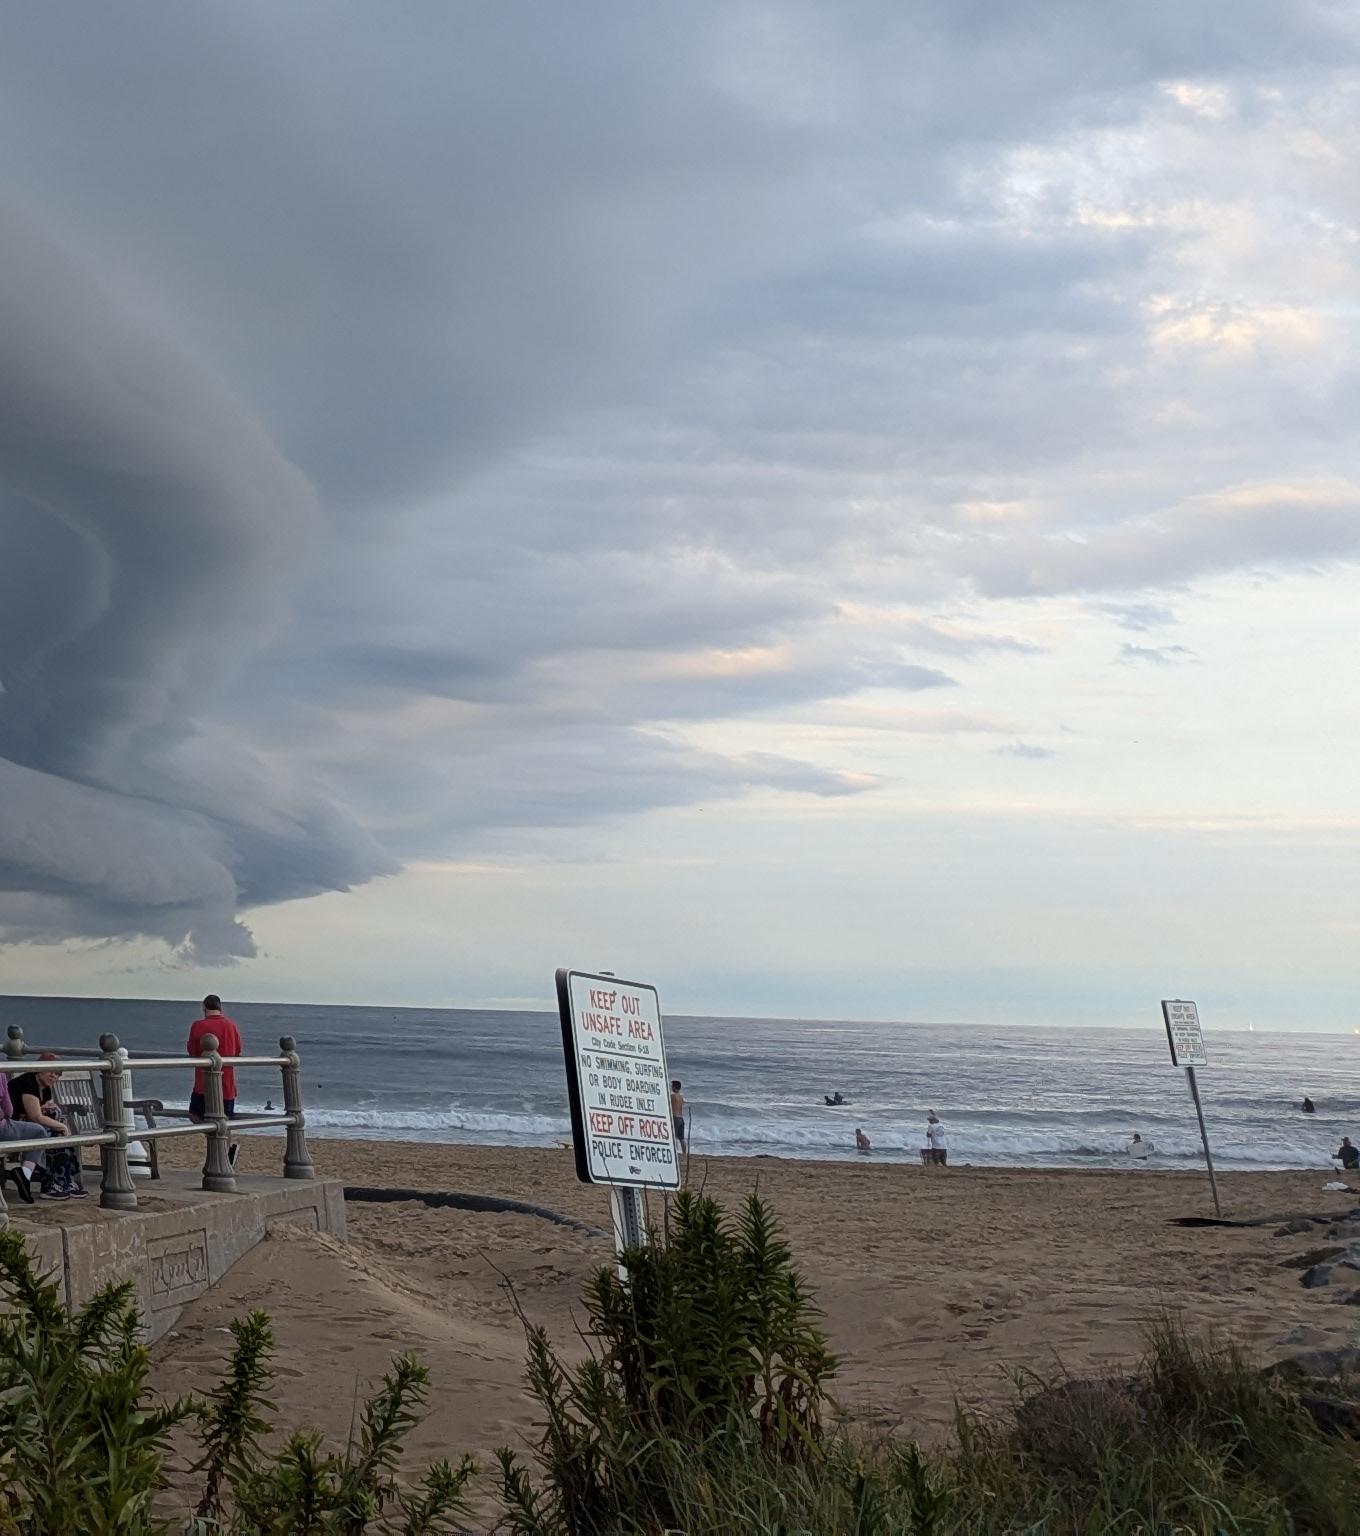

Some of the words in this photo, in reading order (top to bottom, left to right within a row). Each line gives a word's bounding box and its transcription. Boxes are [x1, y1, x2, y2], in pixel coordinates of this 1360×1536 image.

[590, 989, 616, 1011] KEEP
[622, 995, 640, 1016] OUT
[581, 1011, 623, 1036] UNSAFE
[628, 1019, 655, 1041] AREA
[591, 1036, 602, 1048] City
[581, 1055, 592, 1068] NO
[635, 1062, 664, 1079] SURFING
[588, 1073, 599, 1087] OR
[602, 1075, 622, 1090] BODY
[626, 1078, 661, 1096] BOARDING
[598, 1092, 607, 1105] IN
[610, 1093, 633, 1109] RUDEE
[636, 1097, 655, 1112] INLET
[589, 1112, 614, 1133] KEEP
[617, 1116, 635, 1136] OFF
[639, 1118, 670, 1140] ROCKS
[592, 1140, 623, 1159] POLICE
[629, 1144, 673, 1164] ENFORCED
